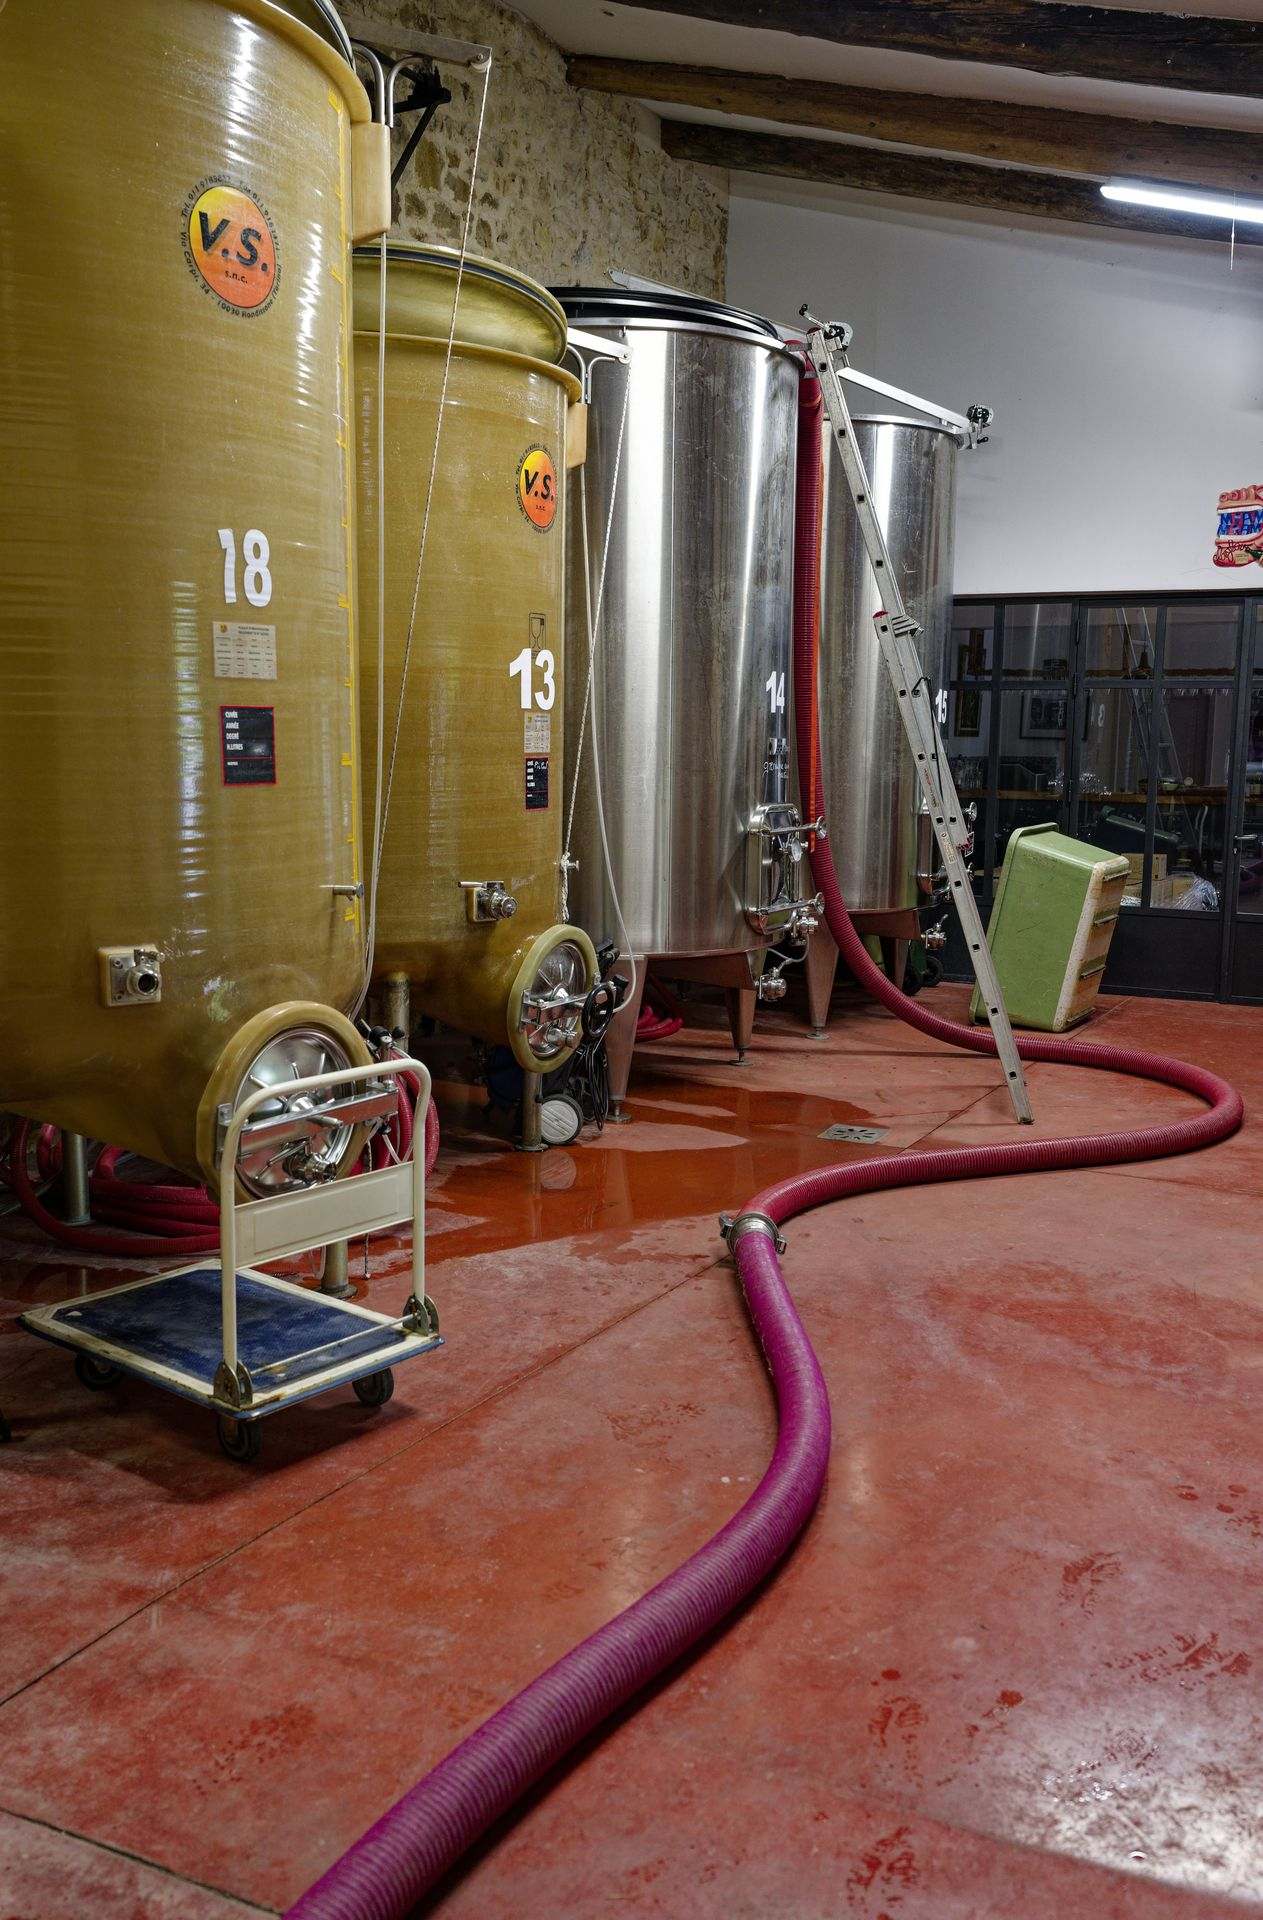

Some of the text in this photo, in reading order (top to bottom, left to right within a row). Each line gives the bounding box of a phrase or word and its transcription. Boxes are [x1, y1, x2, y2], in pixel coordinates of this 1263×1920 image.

[199, 210, 268, 273] V.S.
[225, 270, 248, 284] s.n.c.
[524, 469, 554, 502] V.S.
[218, 528, 272, 607] 18
[509, 648, 556, 710] 13
[765, 670, 785, 714] 14
[935, 689, 948, 724] 15
